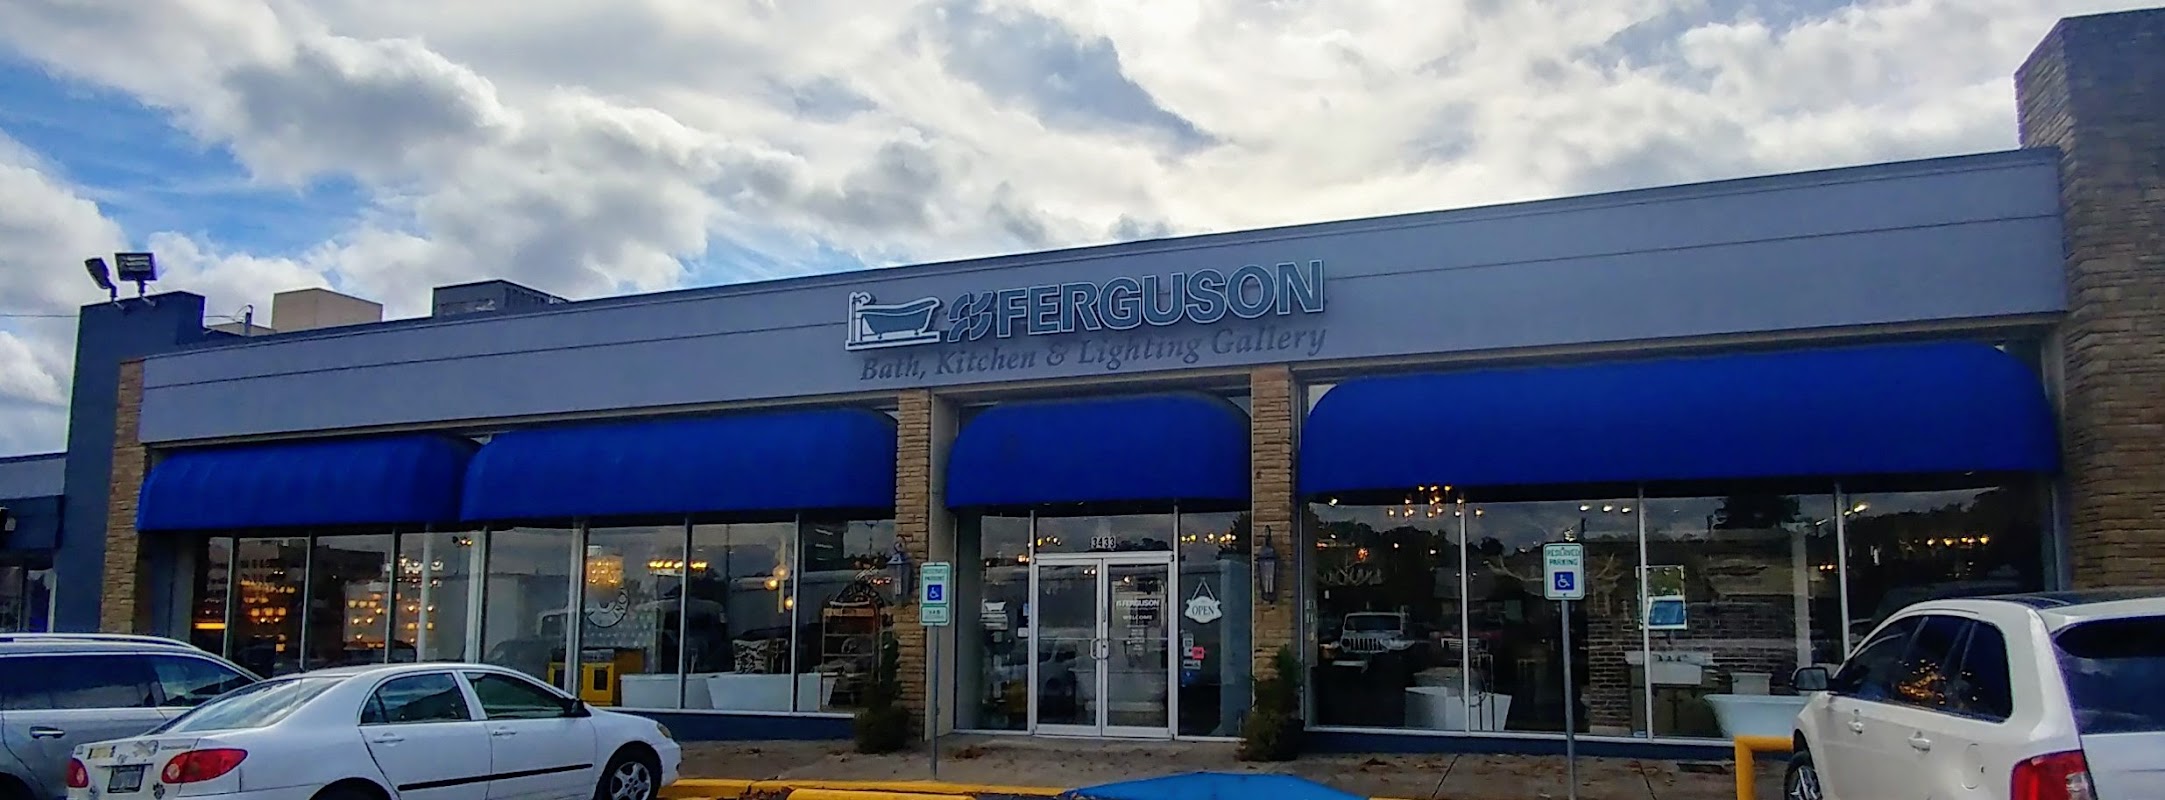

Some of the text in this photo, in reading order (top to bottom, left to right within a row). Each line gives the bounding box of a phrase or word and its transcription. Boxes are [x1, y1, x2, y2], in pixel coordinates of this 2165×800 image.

[996, 259, 1325, 339] FERGUSON
[860, 325, 1326, 381] Bath, Kitchen & Lighting Gallery
[1091, 537, 1116, 549] 3433
[1192, 605, 1215, 616] OPEN
